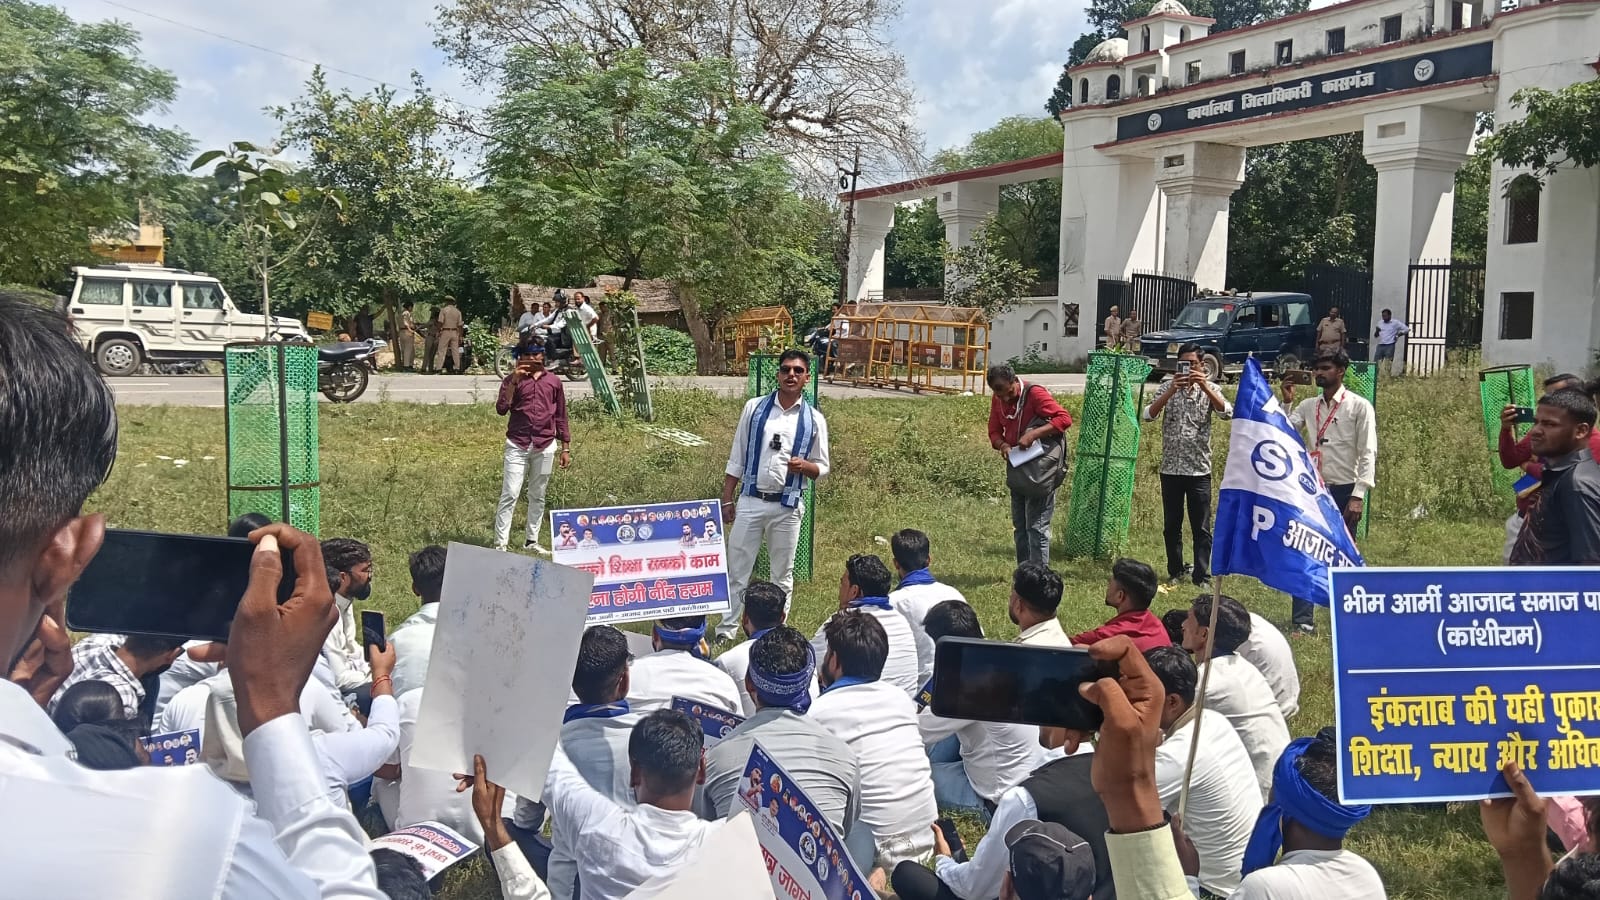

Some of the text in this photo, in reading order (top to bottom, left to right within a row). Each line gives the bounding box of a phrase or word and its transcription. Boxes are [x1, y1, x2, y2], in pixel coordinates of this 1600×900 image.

[1187, 70, 1375, 120] कार्यालय जिलाधिकारी कासगंज
[1254, 441, 1289, 479] S
[1251, 505, 1276, 541] P
[1282, 519, 1336, 567] आजाद
[609, 554, 643, 577] शिक्षा
[646, 551, 687, 573] सबको
[690, 553, 720, 569] काम
[612, 582, 647, 606] होगी
[649, 579, 676, 601] नींद
[679, 580, 714, 600] हराम
[1343, 585, 1385, 614] भीम
[1391, 584, 1442, 614] आर्मी
[1448, 592, 1516, 613] आजाद
[1521, 591, 1579, 612] समाज
[1437, 618, 1543, 655] (कांशीराम)
[1368, 687, 1456, 732] इंकलाब
[1462, 686, 1497, 725] की
[1503, 684, 1545, 724] यही
[1349, 737, 1421, 781] शिक्षा,
[1430, 742, 1488, 773] न्याय
[1496, 731, 1539, 771] और
